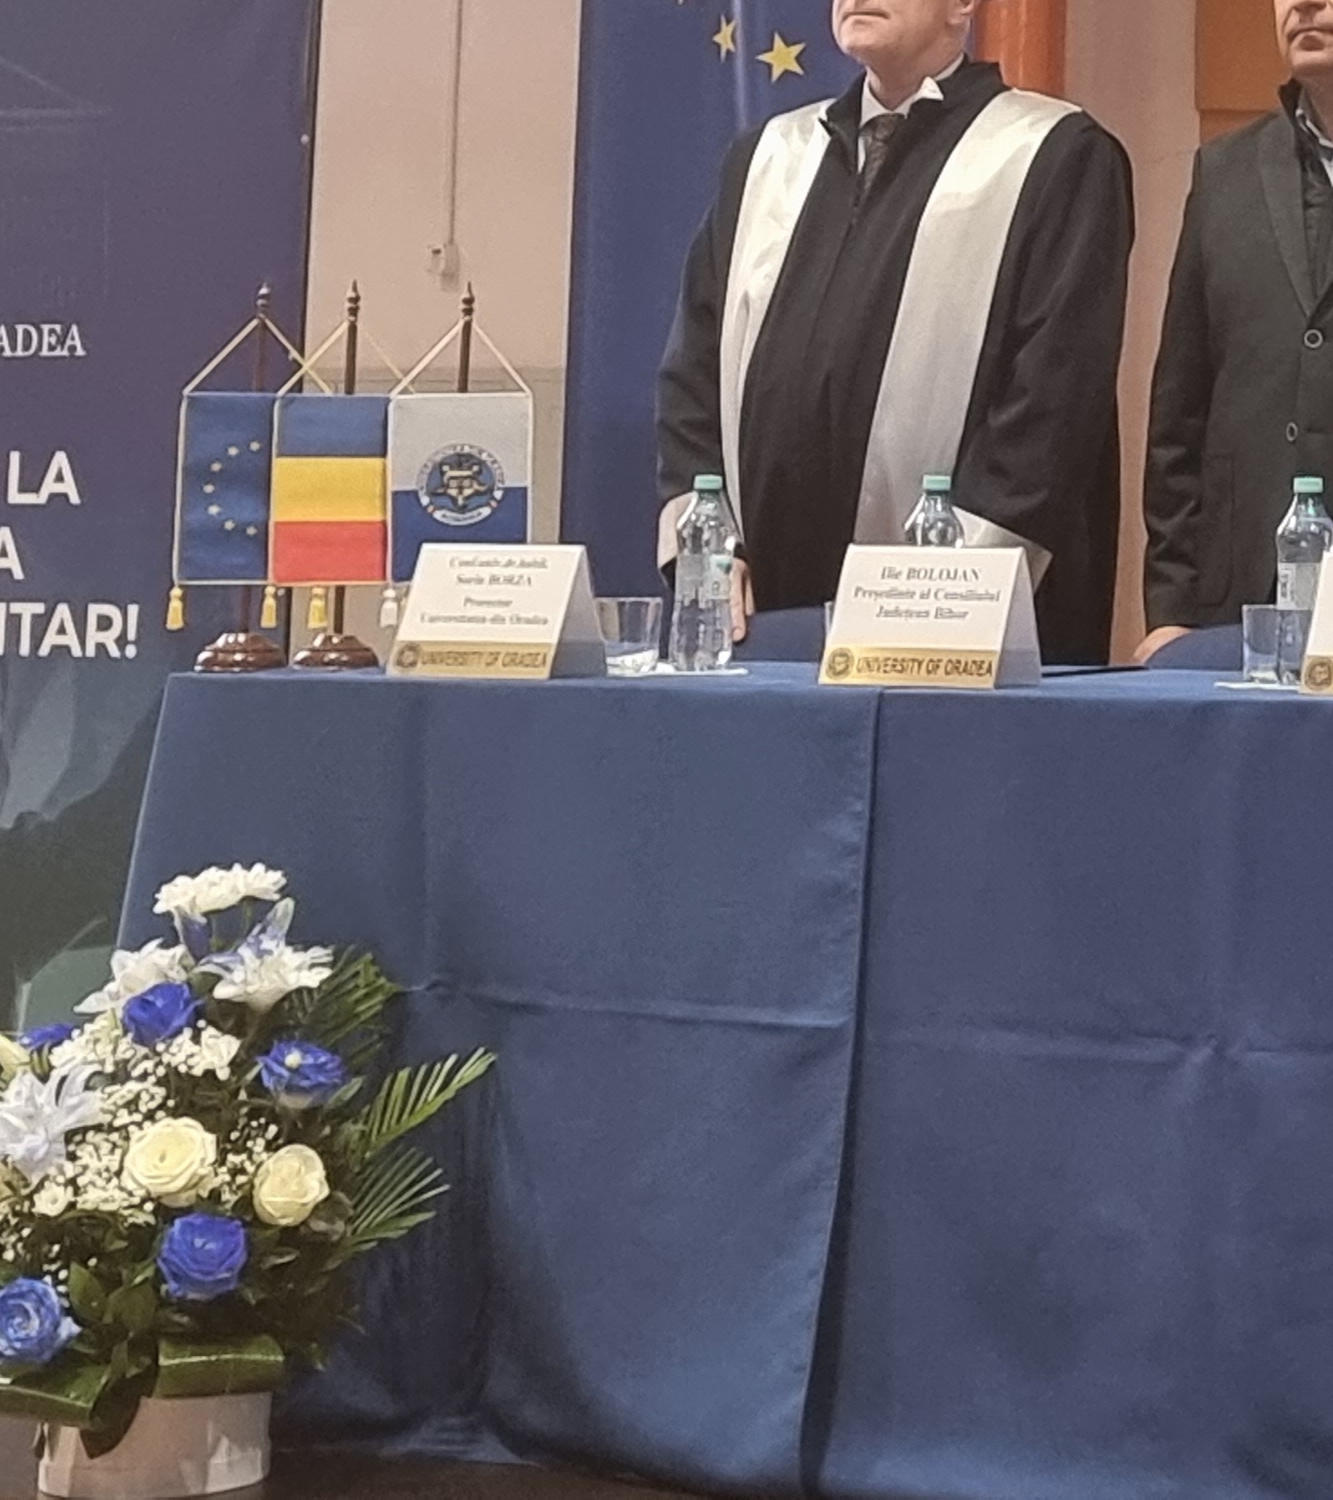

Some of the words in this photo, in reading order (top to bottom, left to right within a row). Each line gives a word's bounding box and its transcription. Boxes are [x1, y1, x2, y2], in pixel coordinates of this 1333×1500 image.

[7, 450, 81, 505] LA
[906, 567, 982, 582] BOLOJAN
[856, 657, 924, 675] UNIVERSITY
[927, 658, 941, 676] OF
[944, 659, 993, 677] ORADEA
